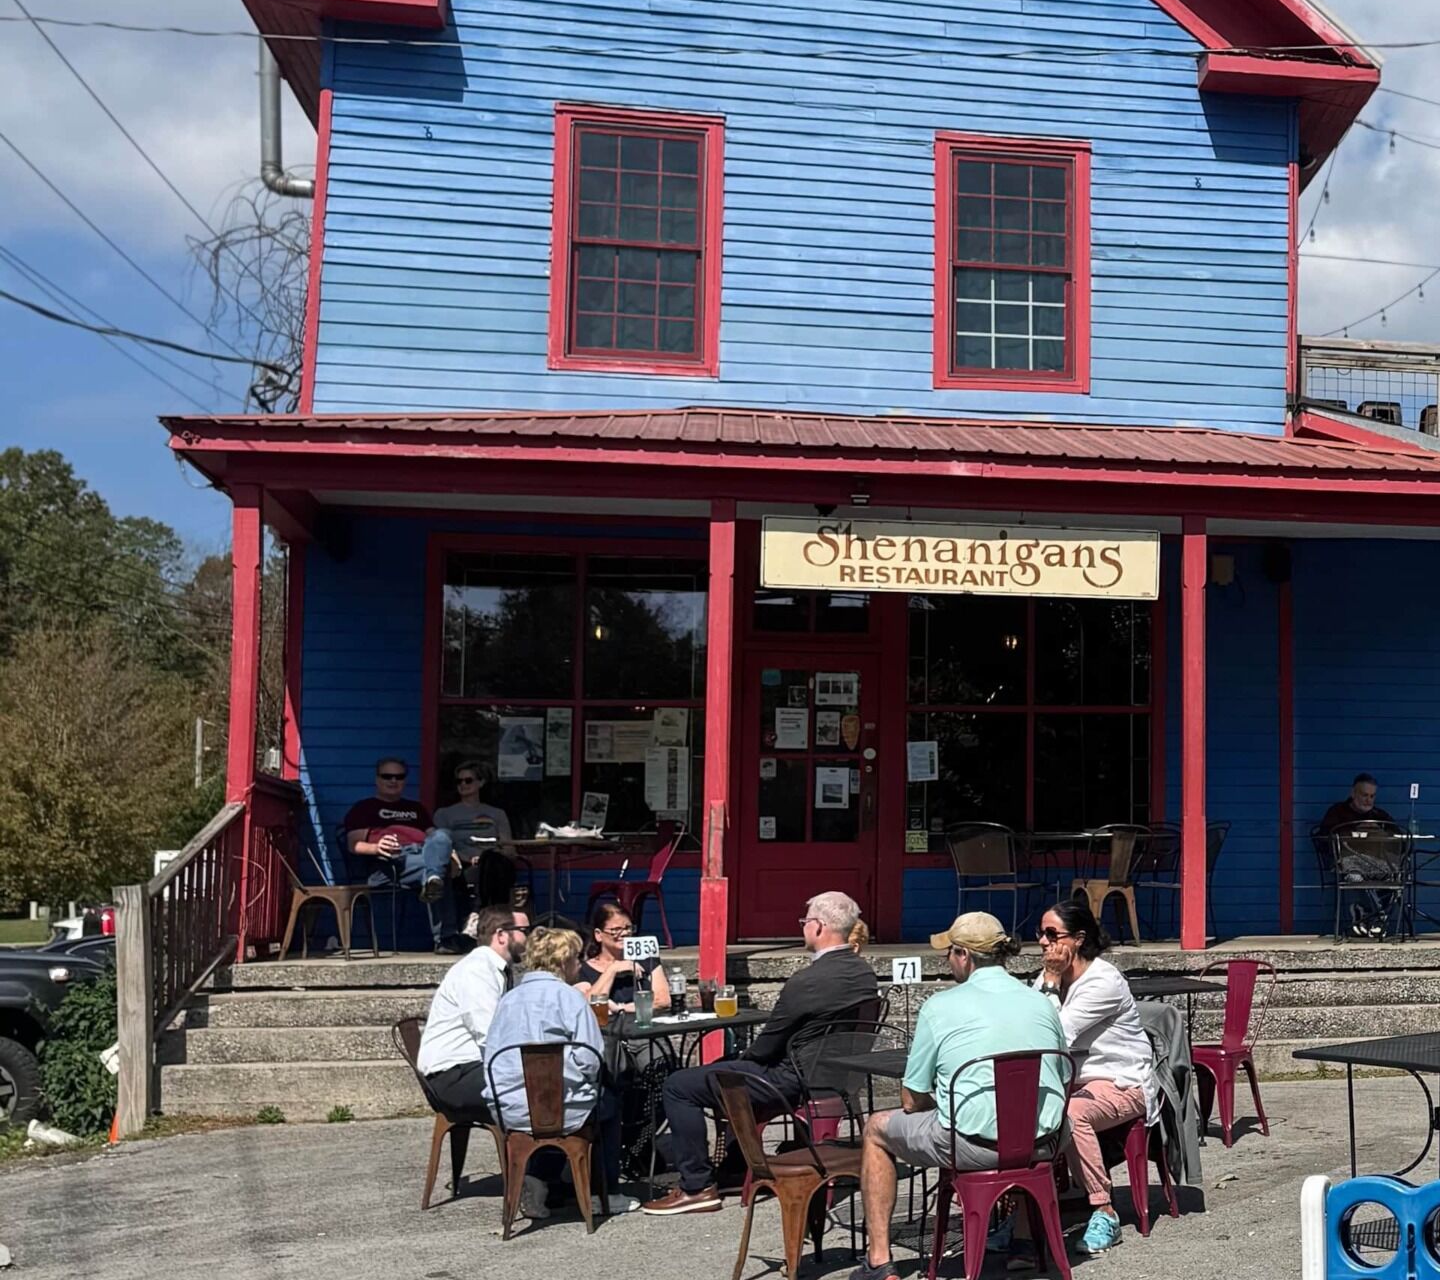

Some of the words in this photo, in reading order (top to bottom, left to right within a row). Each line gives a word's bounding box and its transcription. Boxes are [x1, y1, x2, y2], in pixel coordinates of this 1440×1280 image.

[803, 523, 1123, 588] Shenanigans
[839, 564, 1010, 588] RESTAURANT
[626, 941, 642, 956] 58
[644, 940, 657, 955] 53
[897, 962, 917, 979] 71
